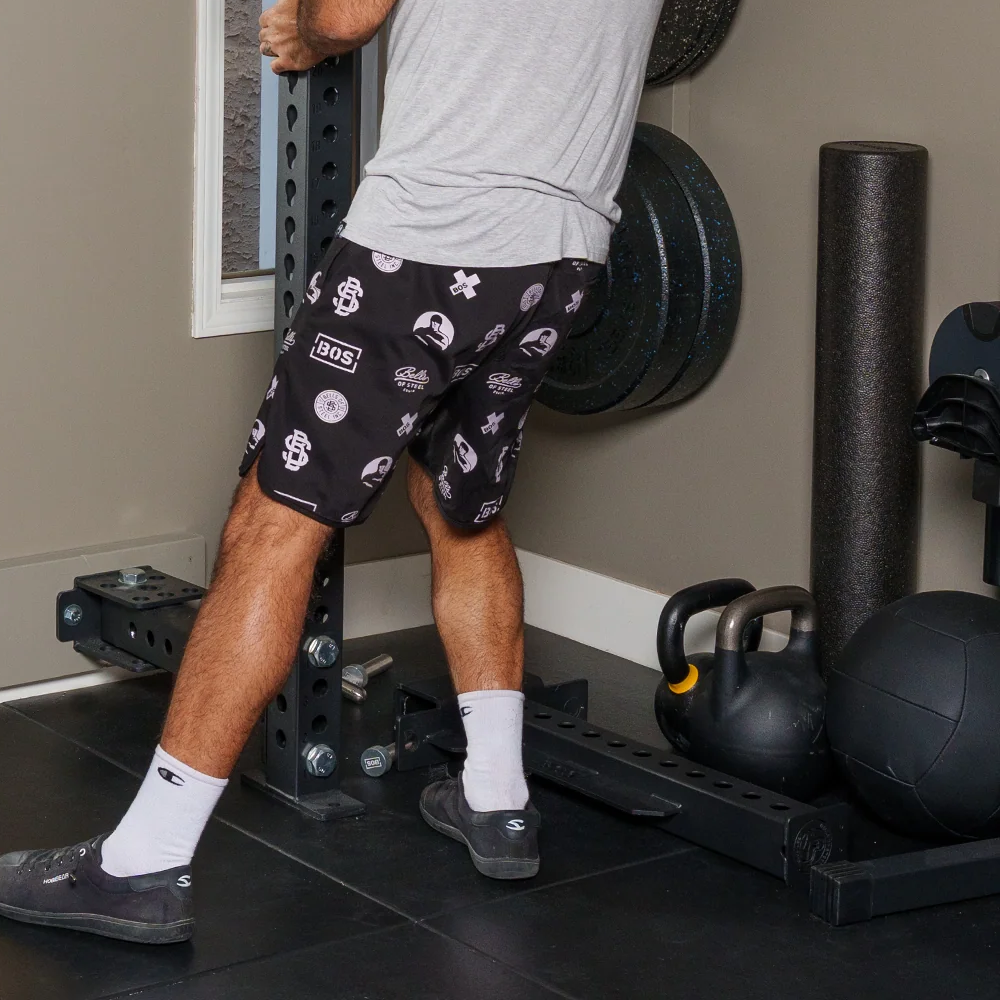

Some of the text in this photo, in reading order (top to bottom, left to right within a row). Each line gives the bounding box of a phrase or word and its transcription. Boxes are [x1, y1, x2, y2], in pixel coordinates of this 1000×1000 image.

[453, 282, 468, 294] BOS
[317, 340, 354, 366] BOS
[395, 367, 429, 382] Bells
[407, 382, 424, 390] STEEL
